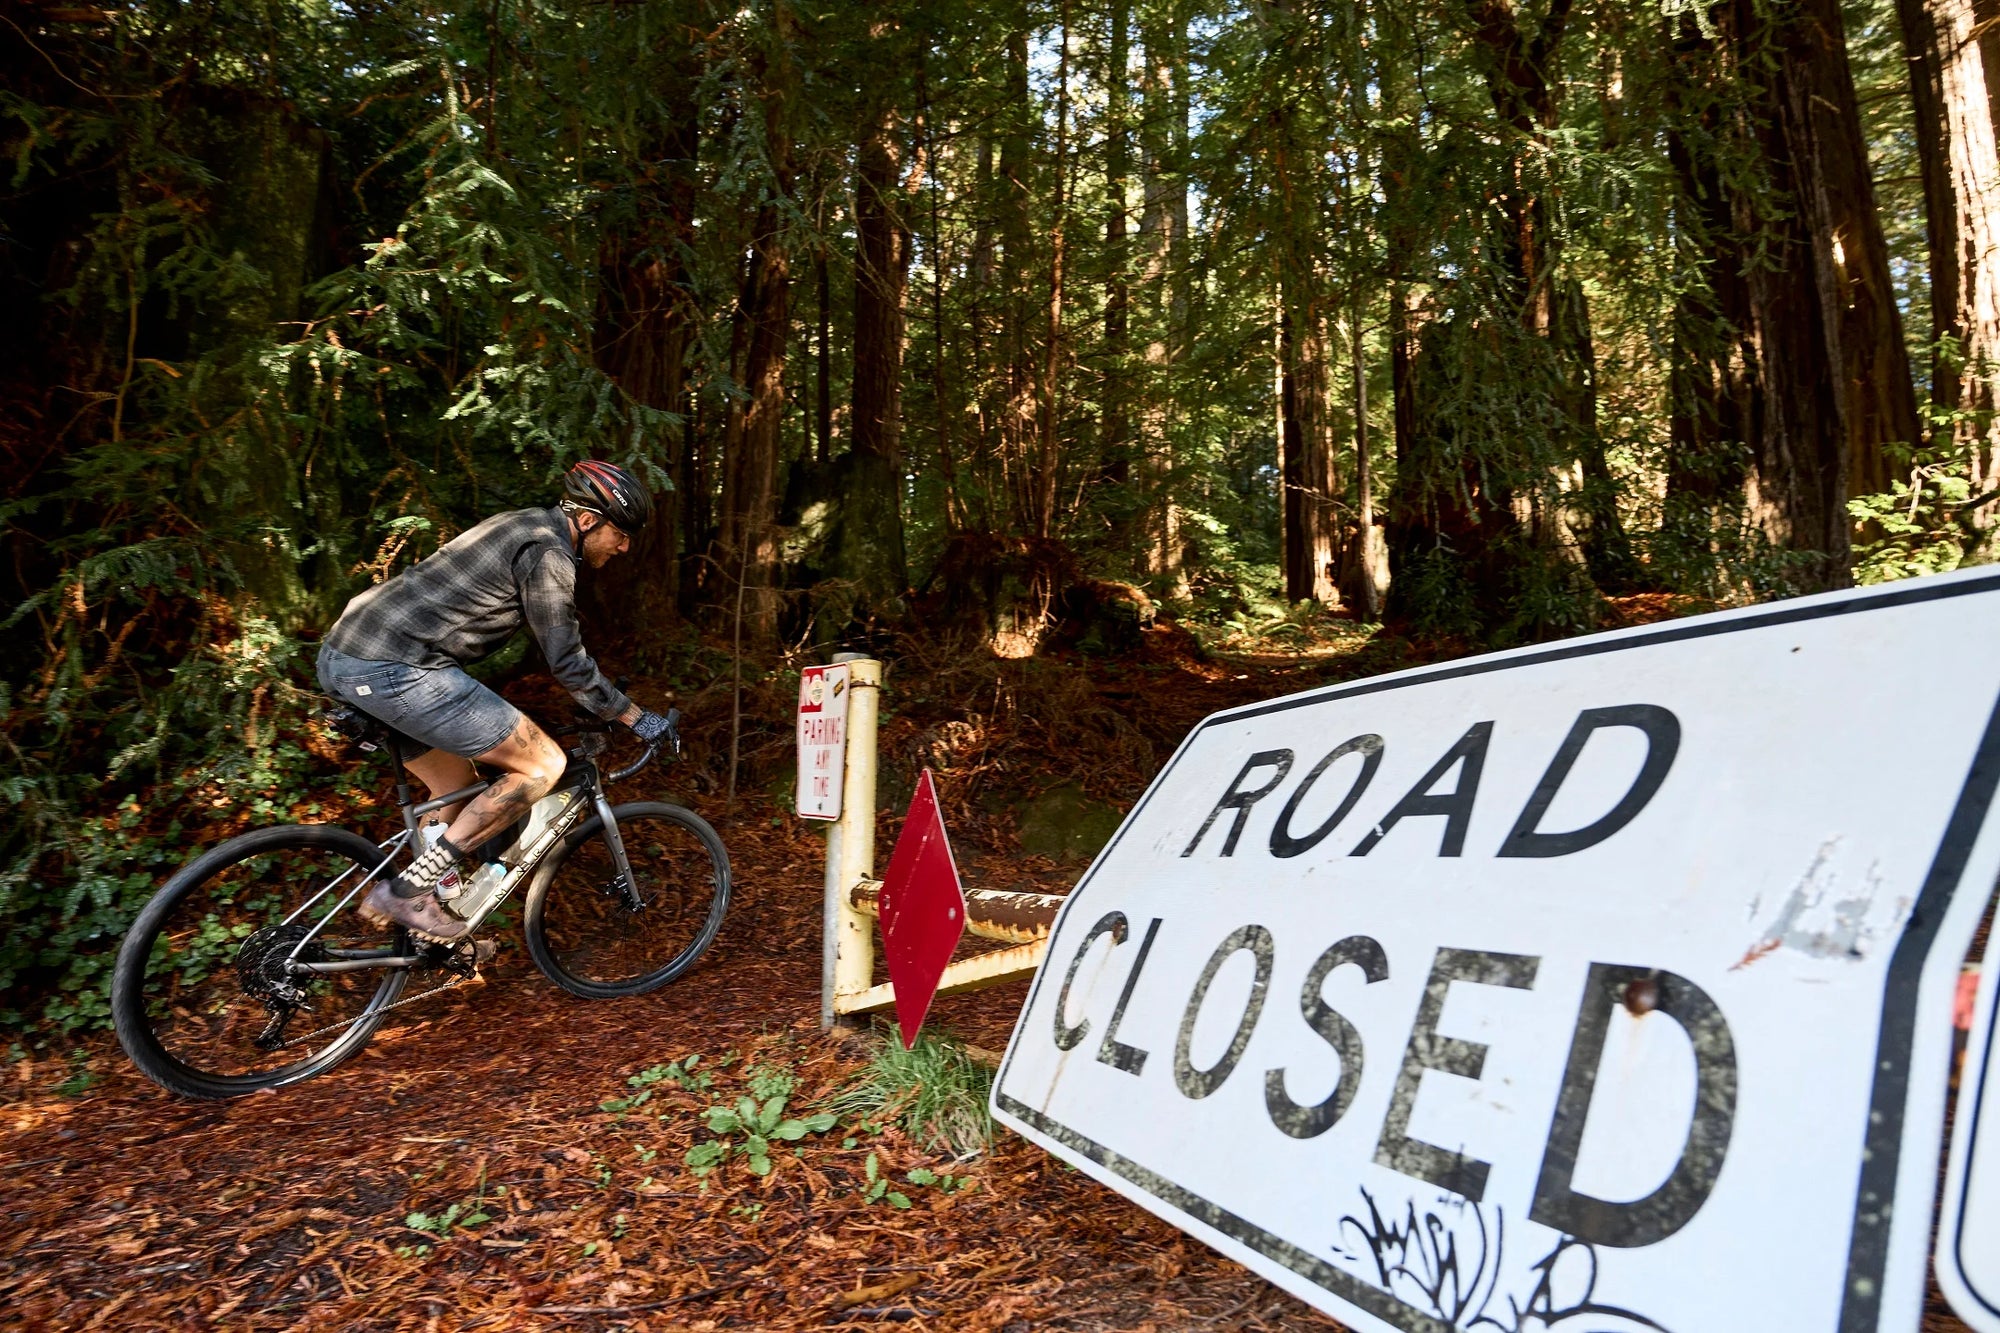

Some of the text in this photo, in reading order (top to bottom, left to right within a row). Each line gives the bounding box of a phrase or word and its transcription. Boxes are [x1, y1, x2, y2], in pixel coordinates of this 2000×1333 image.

[803, 716, 841, 745] PARKING
[815, 749, 831, 769] ANY
[813, 776, 830, 797] TIME
[1181, 703, 1681, 859] ROAD
[1052, 910, 1738, 1248] CLOSED
